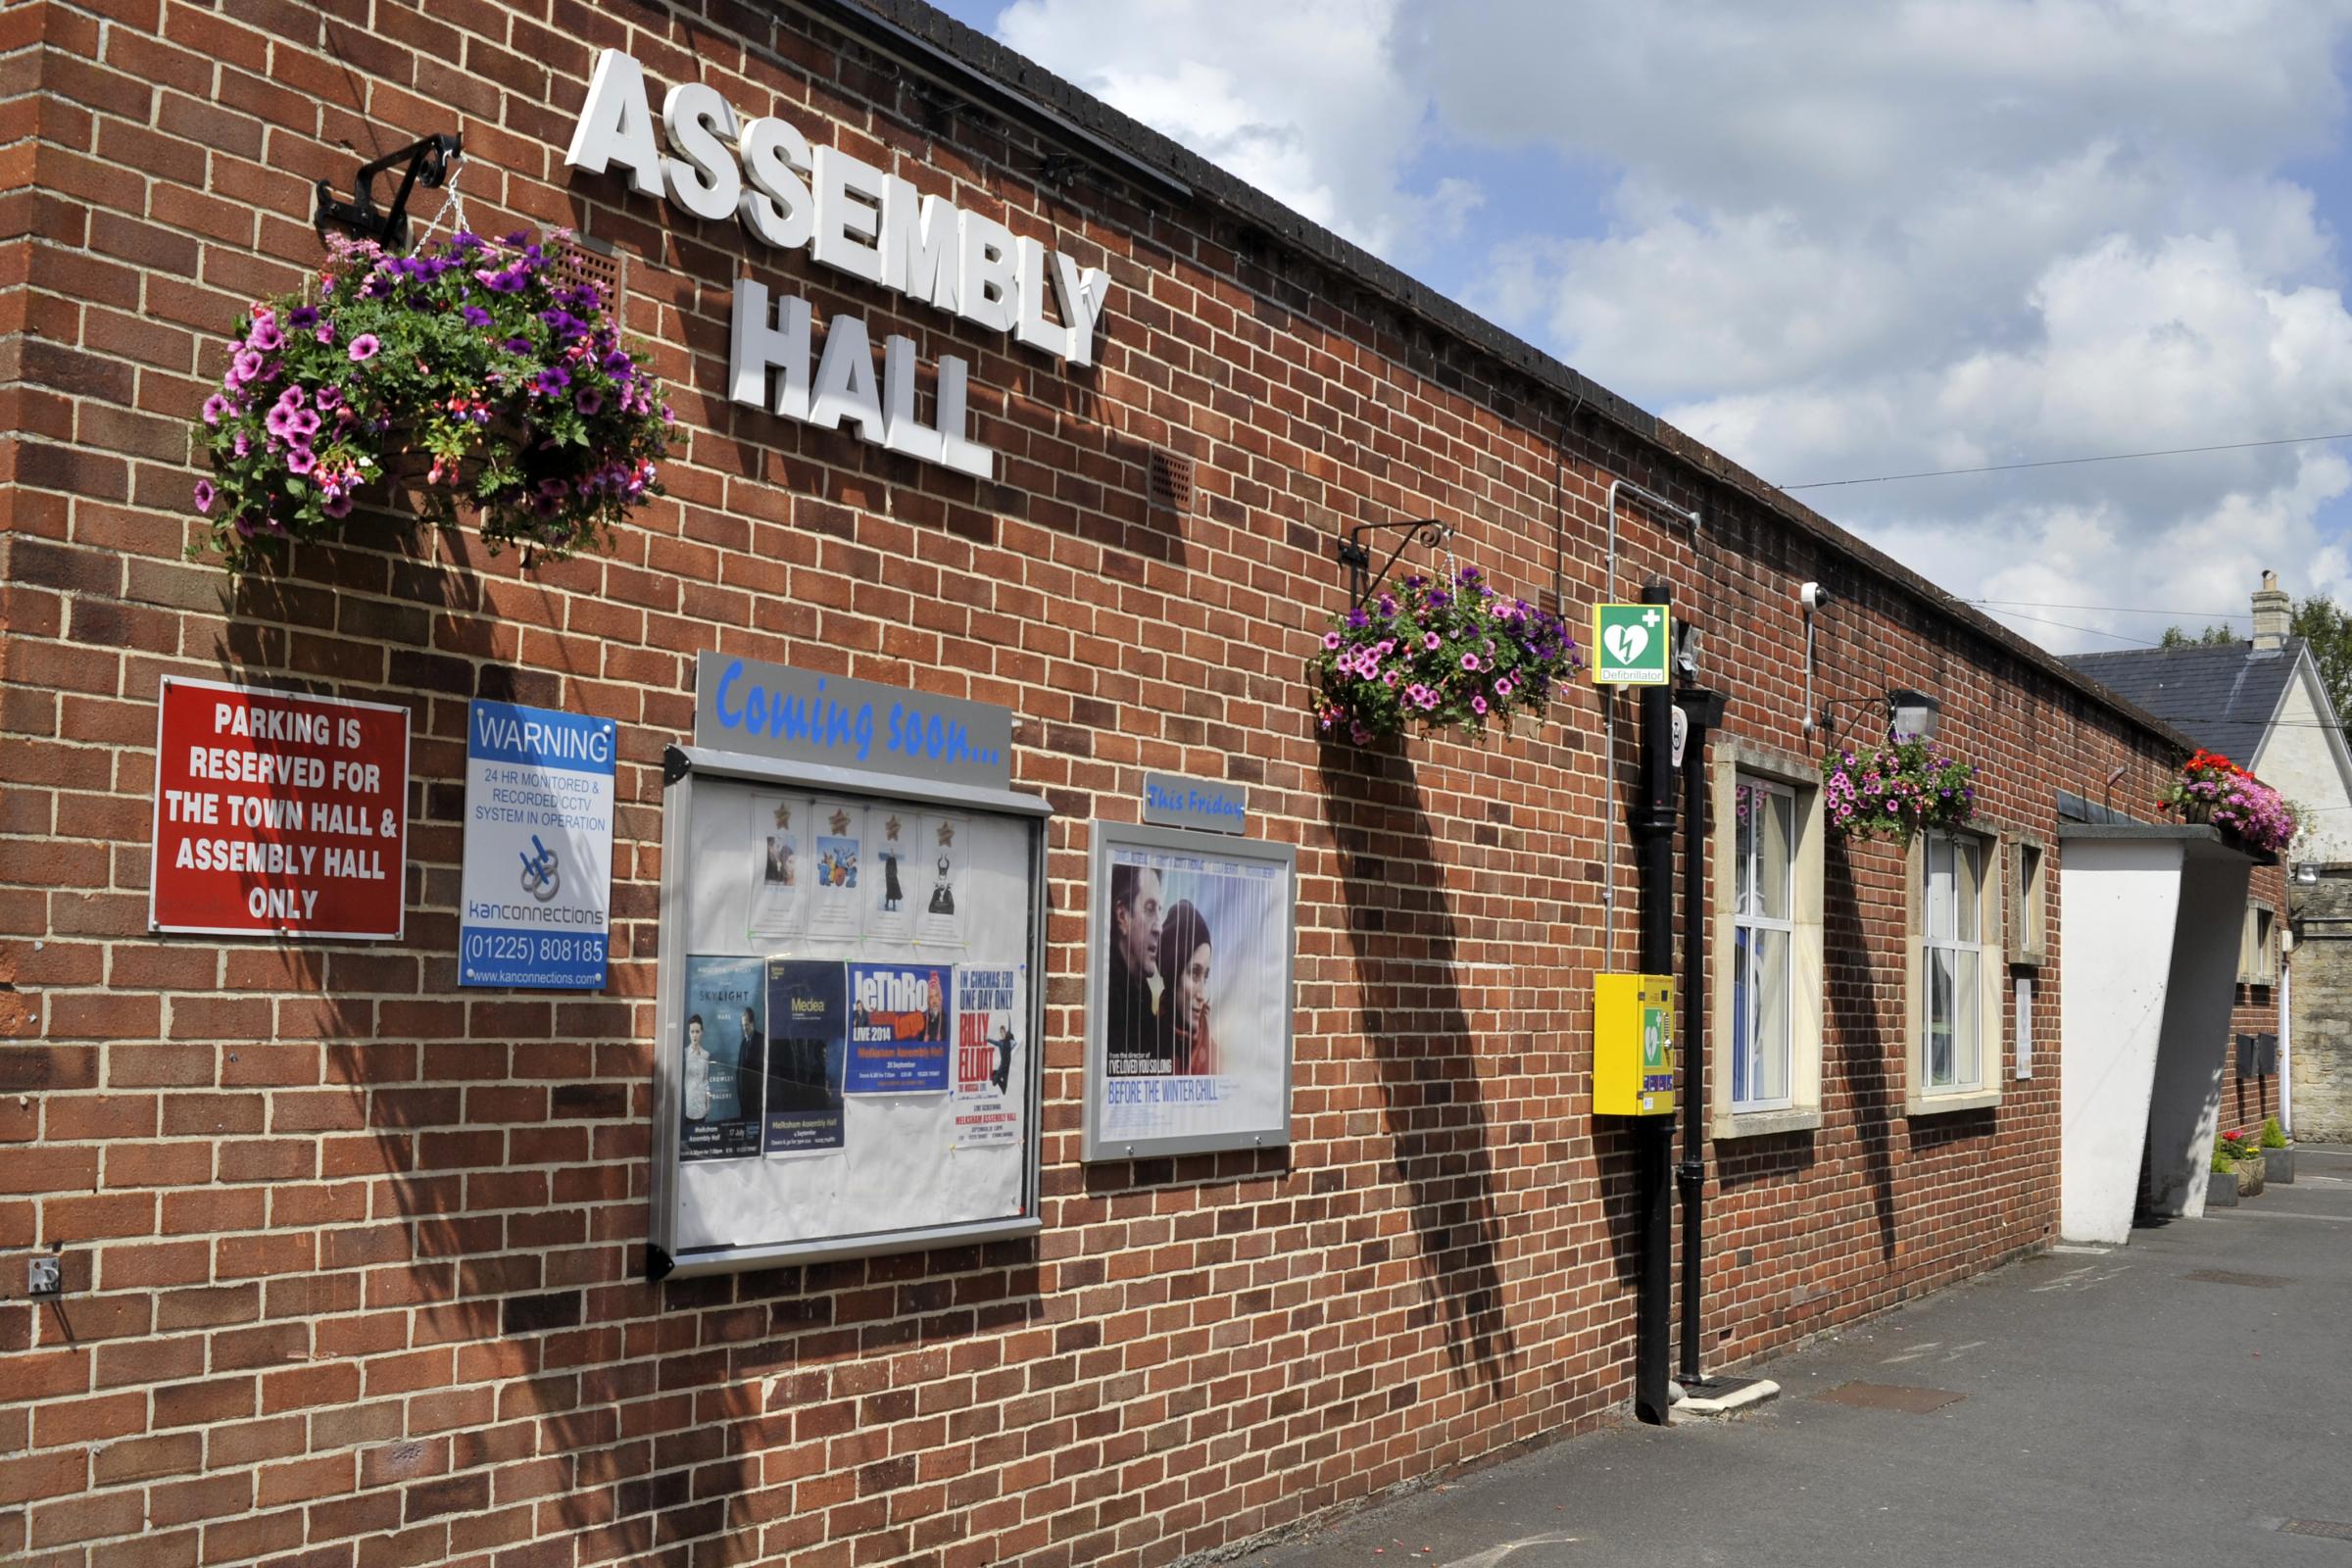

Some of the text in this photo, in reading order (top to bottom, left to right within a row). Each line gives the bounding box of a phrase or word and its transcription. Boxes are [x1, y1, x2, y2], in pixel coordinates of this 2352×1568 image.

[564, 48, 1111, 368] ASSEMBLY
[729, 278, 993, 479] HALL
[1602, 669, 1661, 680] Defibrillator
[715, 660, 1000, 765] Coming soon...
[215, 703, 361, 749] PARKING IS
[477, 716, 609, 762] WARNING
[189, 746, 380, 794] RESERVED FOR
[484, 767, 600, 794] 24 HR MONITORED &
[493, 788, 592, 811] RECORDED CCTV
[1148, 785, 1244, 821] This Friday
[166, 790, 397, 839] THE TOWN HALL &
[475, 806, 606, 832] SYSTEM IN OPERATION
[175, 838, 385, 880] ASSEMBLY HALL
[249, 887, 318, 920] ONLY
[468, 900, 604, 925] kanconnections
[466, 935, 603, 962] (01225) 808185
[473, 970, 596, 985] www.kanconnections.com
[960, 971, 1013, 988] IN CINEMAS FOR
[699, 990, 750, 1002] SKYLIGHT
[791, 996, 825, 1012] Medea
[960, 989, 1013, 1010] ONE DAY ONLY
[853, 1026, 870, 1042] LIVE
[871, 1026, 891, 1042] 2014
[959, 1012, 989, 1047] BILLY
[958, 1047, 995, 1083] ELLIOT
[1120, 1059, 1138, 1074] LOVED
[1138, 1059, 1150, 1074] YOU
[1150, 1059, 1157, 1073] SO
[1157, 1059, 1172, 1073] LONG
[1108, 1080, 1142, 1104] BEFORE
[1145, 1080, 1159, 1102] THE
[1161, 1079, 1194, 1102] WINTER
[1196, 1079, 1218, 1102] CHILL
[772, 1120, 802, 1129] Melksham
[802, 1119, 826, 1129] Assembly
[956, 1112, 1016, 1125] MELKSHAM ASSEMBLY HALL
